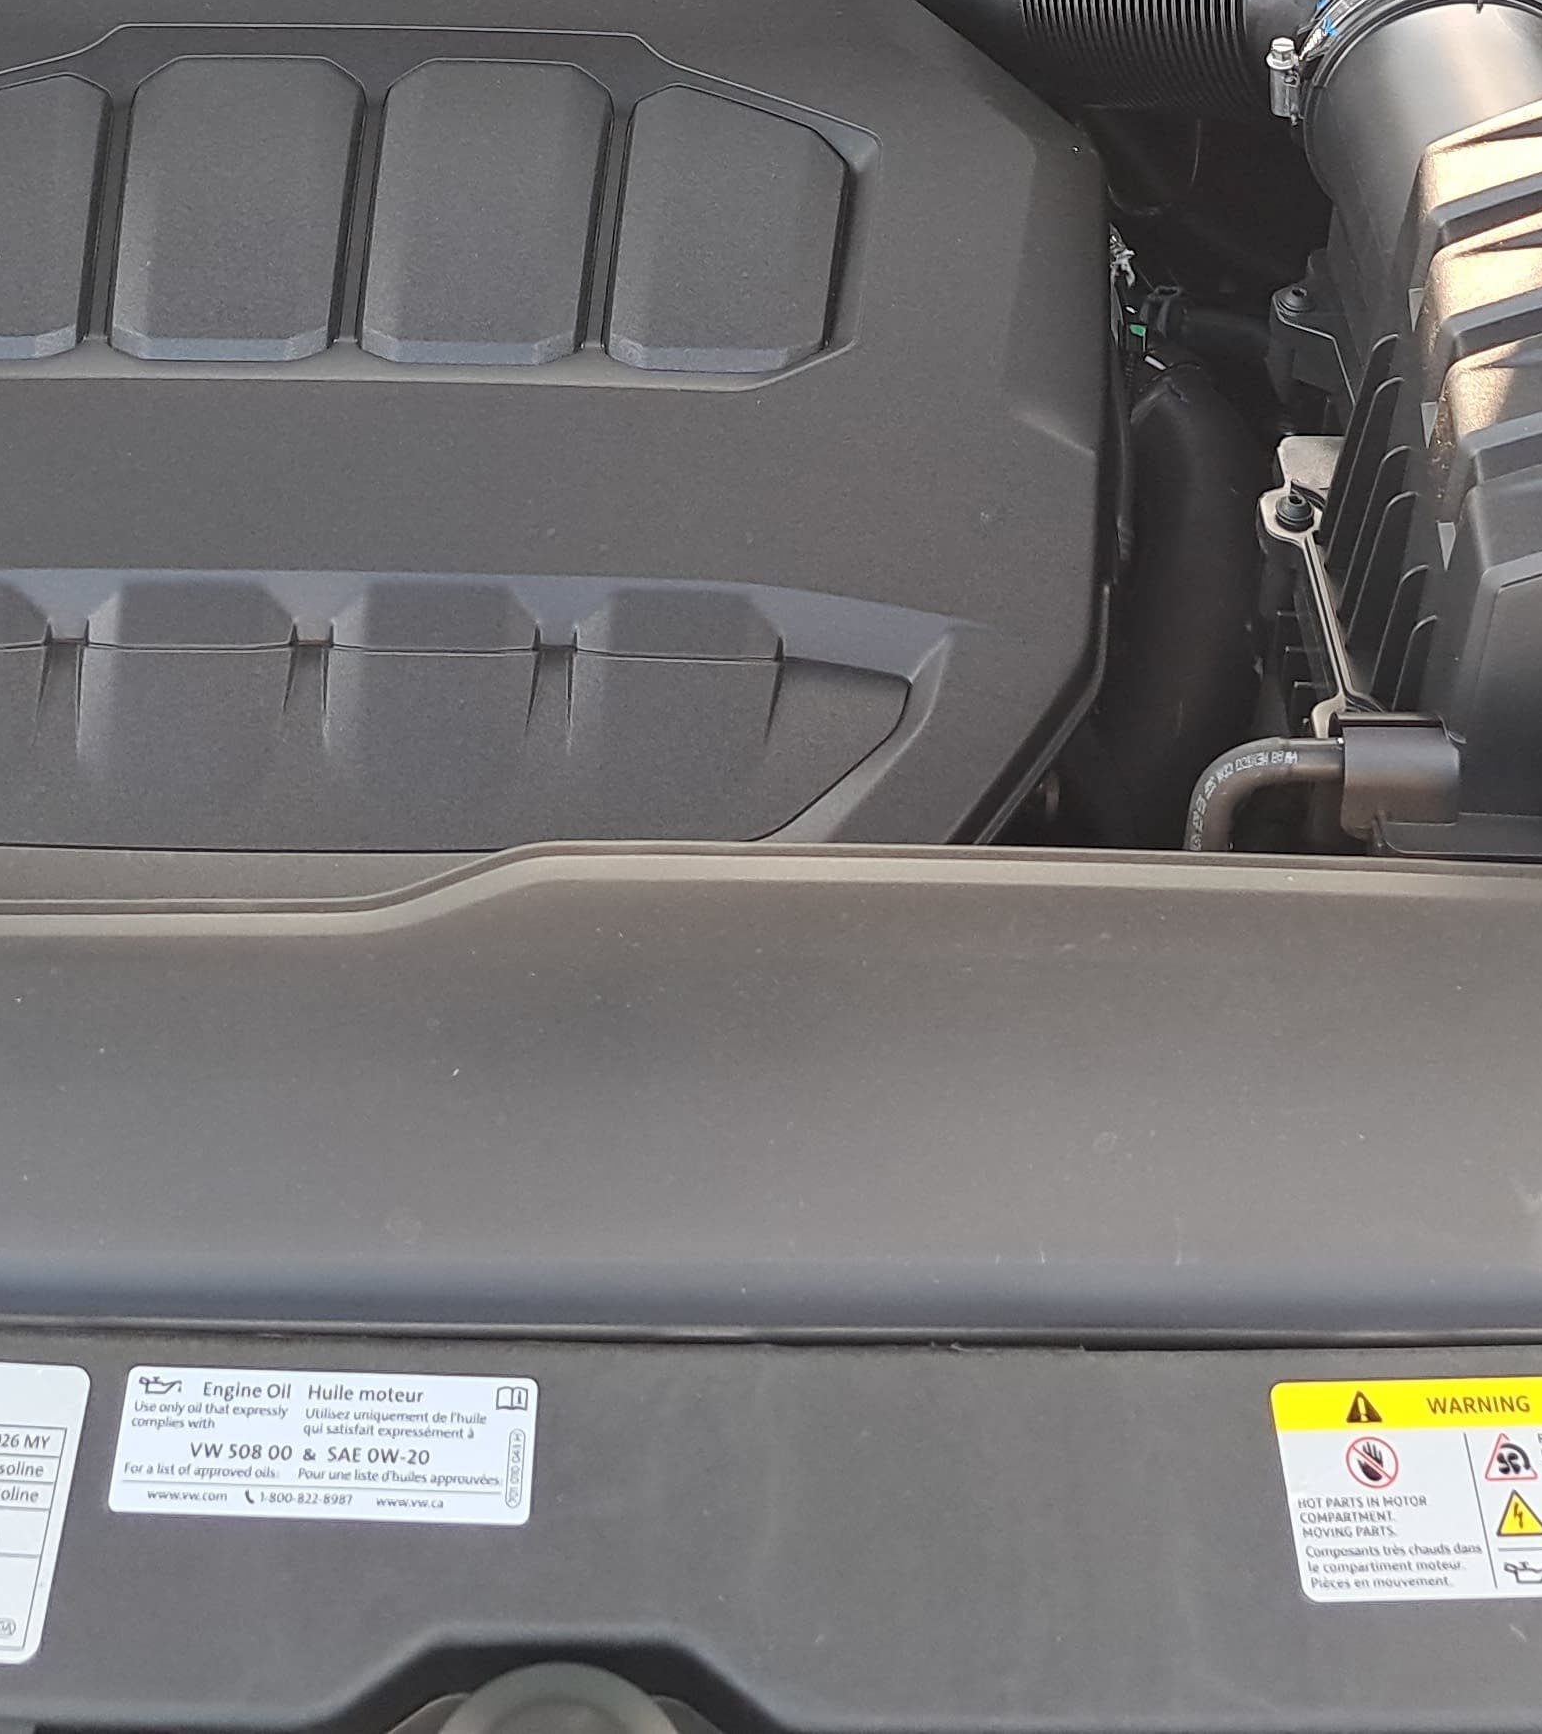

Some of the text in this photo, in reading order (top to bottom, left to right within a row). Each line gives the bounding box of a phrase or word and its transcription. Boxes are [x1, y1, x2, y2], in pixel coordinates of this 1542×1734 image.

[203, 1381, 292, 1402] Engine Oil
[309, 1384, 424, 1403] Huile moteur
[134, 1401, 288, 1419] Use only oil that expressly
[1427, 1395, 1530, 1415] WARNING
[132, 1417, 216, 1430] complies with
[306, 1408, 487, 1425] Utilisez uniquement de l'huile
[304, 1423, 475, 1440] qui satisfait expressément à
[23, 1434, 51, 1449] MY
[190, 1442, 430, 1465] VW 508 00 & SAE 0W-20
[124, 1462, 143, 1474] For
[146, 1465, 154, 1475] a
[157, 1463, 175, 1475] list
[178, 1464, 191, 1475] of
[194, 1466, 251, 1480] approved
[298, 1468, 326, 1480] Pour
[334, 1472, 351, 1481] une
[354, 1470, 379, 1482] liste
[382, 1470, 427, 1484] d'huiles
[148, 1490, 227, 1502] www.vw.com
[260, 1491, 353, 1506] 1-800-822-8987
[376, 1496, 444, 1509] www.vw.ca
[1297, 1495, 1428, 1509] HOT PARTS IN MOTOR
[1302, 1526, 1353, 1539] MOVING
[1305, 1542, 1483, 1559] Composants très chauds dans
[1307, 1561, 1319, 1573] le
[1323, 1561, 1414, 1575] compartiment
[1310, 1576, 1350, 1589] Pièces
[1354, 1577, 1370, 1588] en
